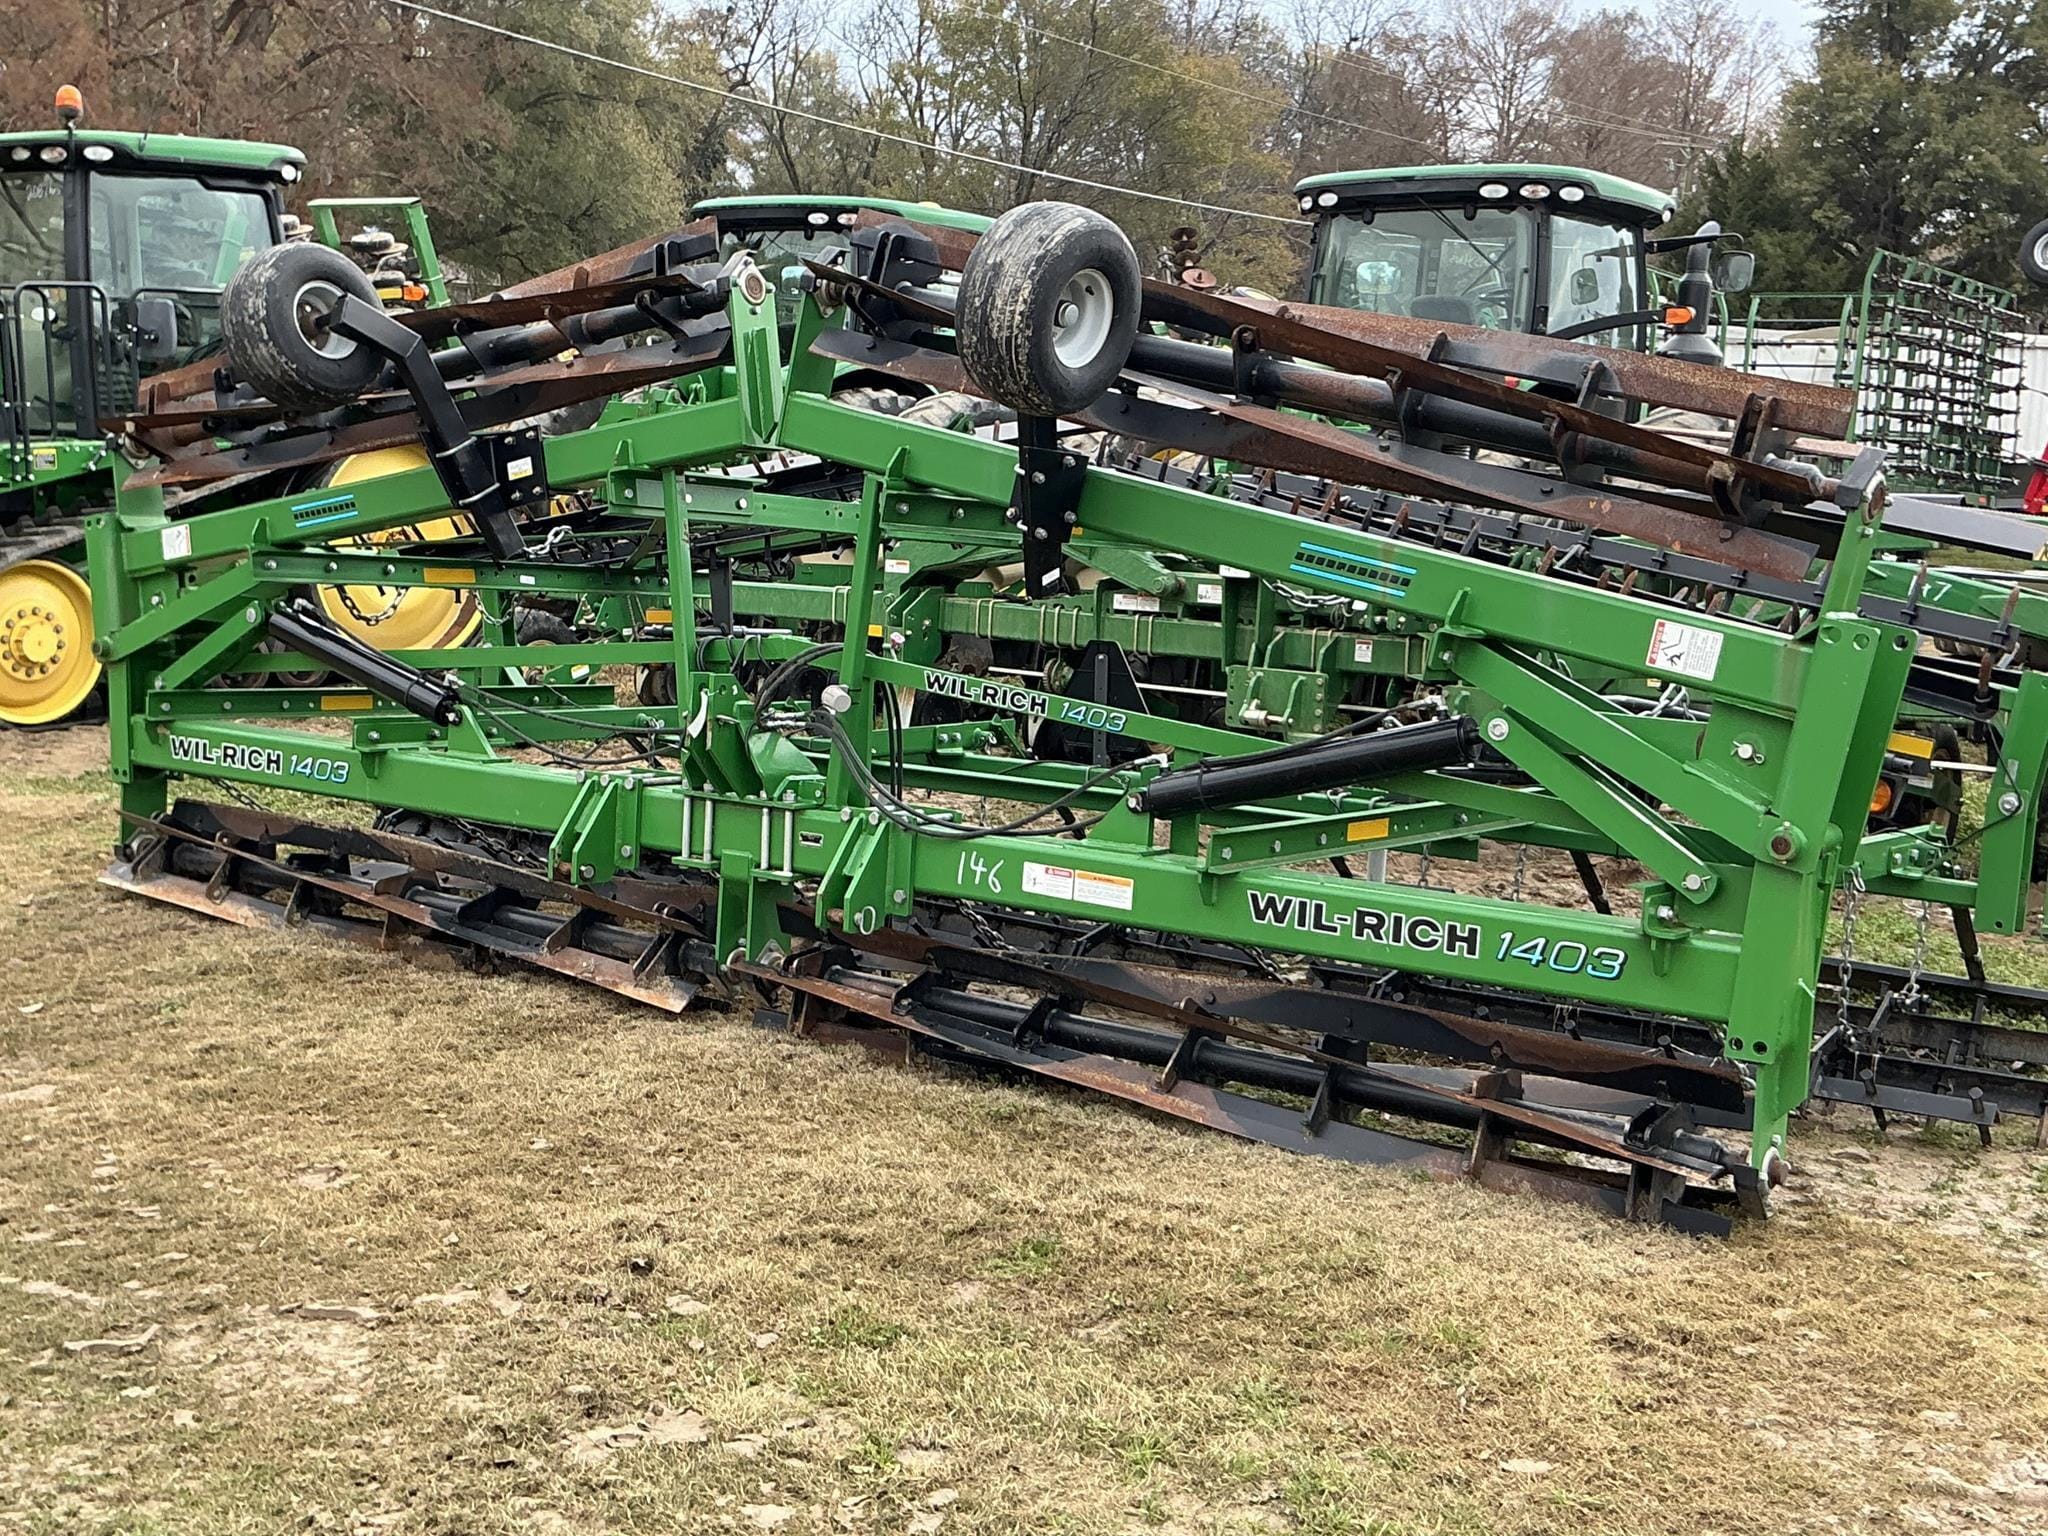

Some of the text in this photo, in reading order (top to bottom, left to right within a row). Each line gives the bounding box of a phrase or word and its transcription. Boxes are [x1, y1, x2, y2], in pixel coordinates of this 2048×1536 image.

[923, 670, 1128, 732] WIL-RICH 1403
[170, 735, 349, 784] WIL-RICH 1403
[957, 850, 1005, 894] 146
[1247, 890, 1628, 980] WIL-RICH 1403
